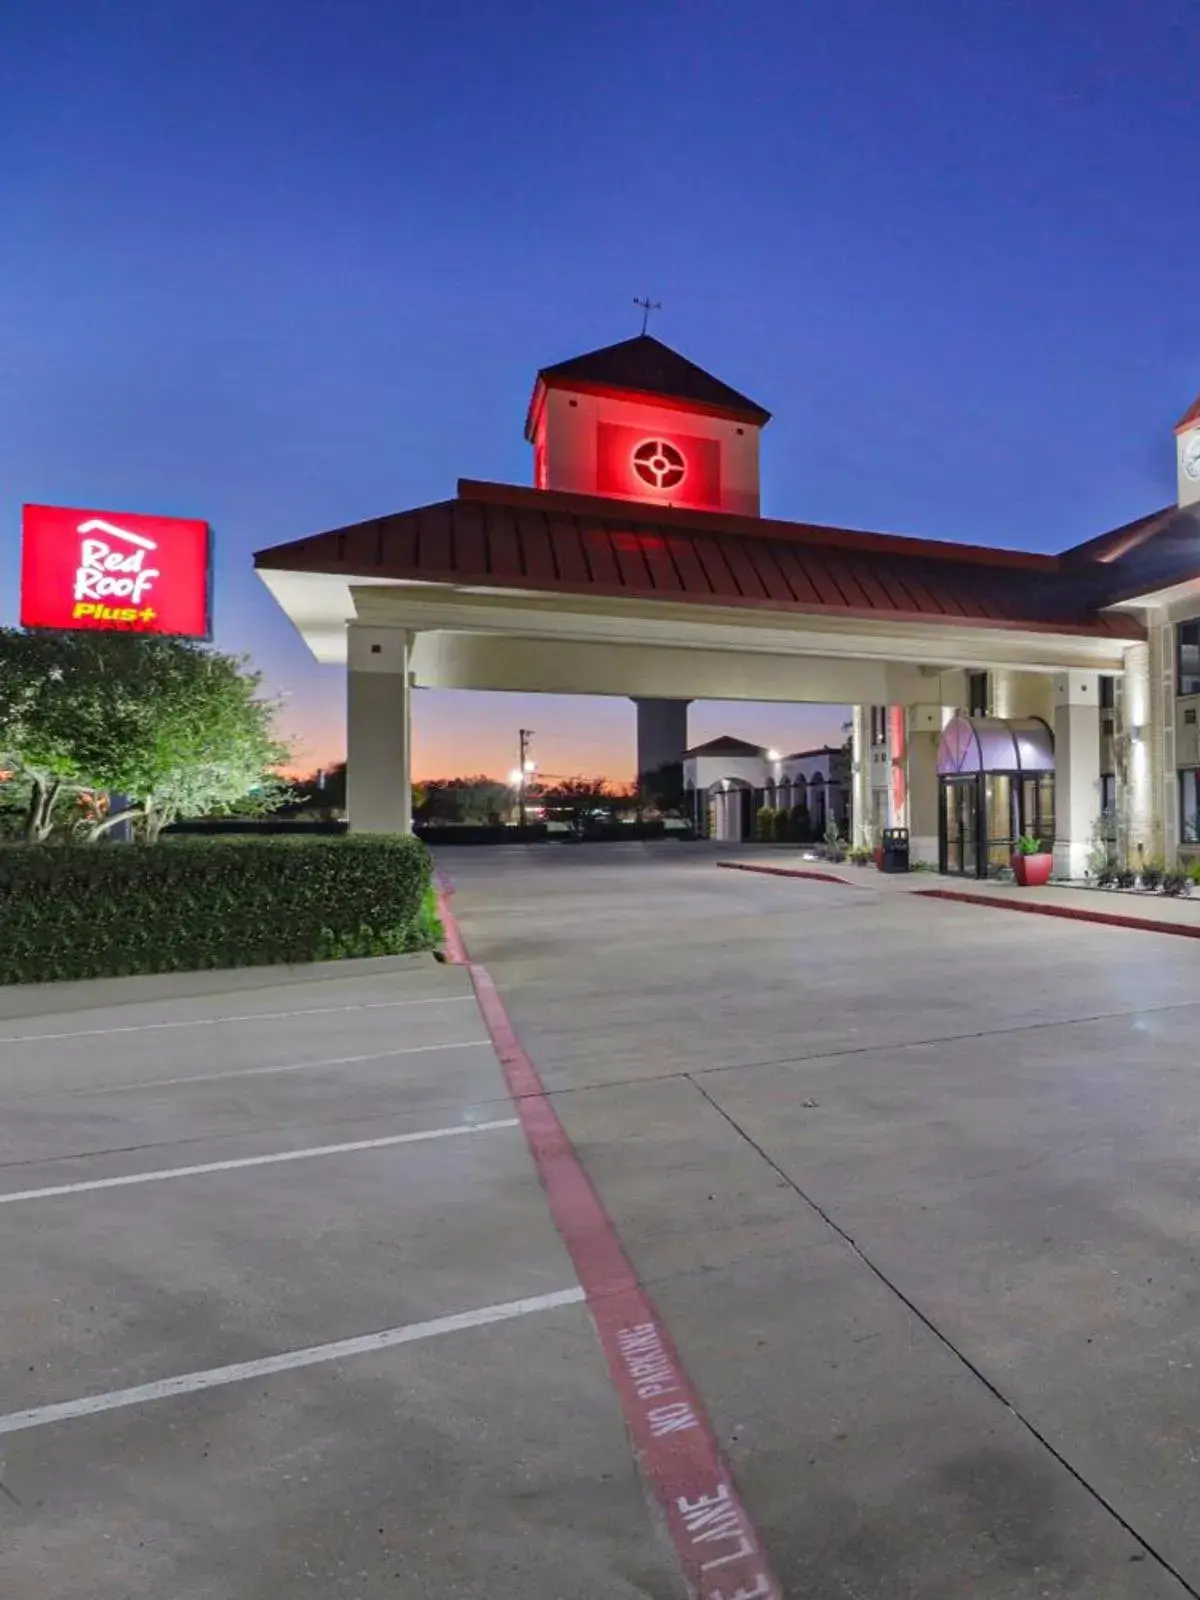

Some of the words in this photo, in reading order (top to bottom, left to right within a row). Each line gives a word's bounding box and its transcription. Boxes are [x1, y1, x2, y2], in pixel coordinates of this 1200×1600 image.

[82, 539, 145, 573] Red
[74, 567, 159, 604] Roof
[73, 603, 156, 621] Plus+
[617, 1322, 679, 1399] PARKING
[646, 1402, 699, 1436] NO
[677, 1484, 754, 1571] LANE
